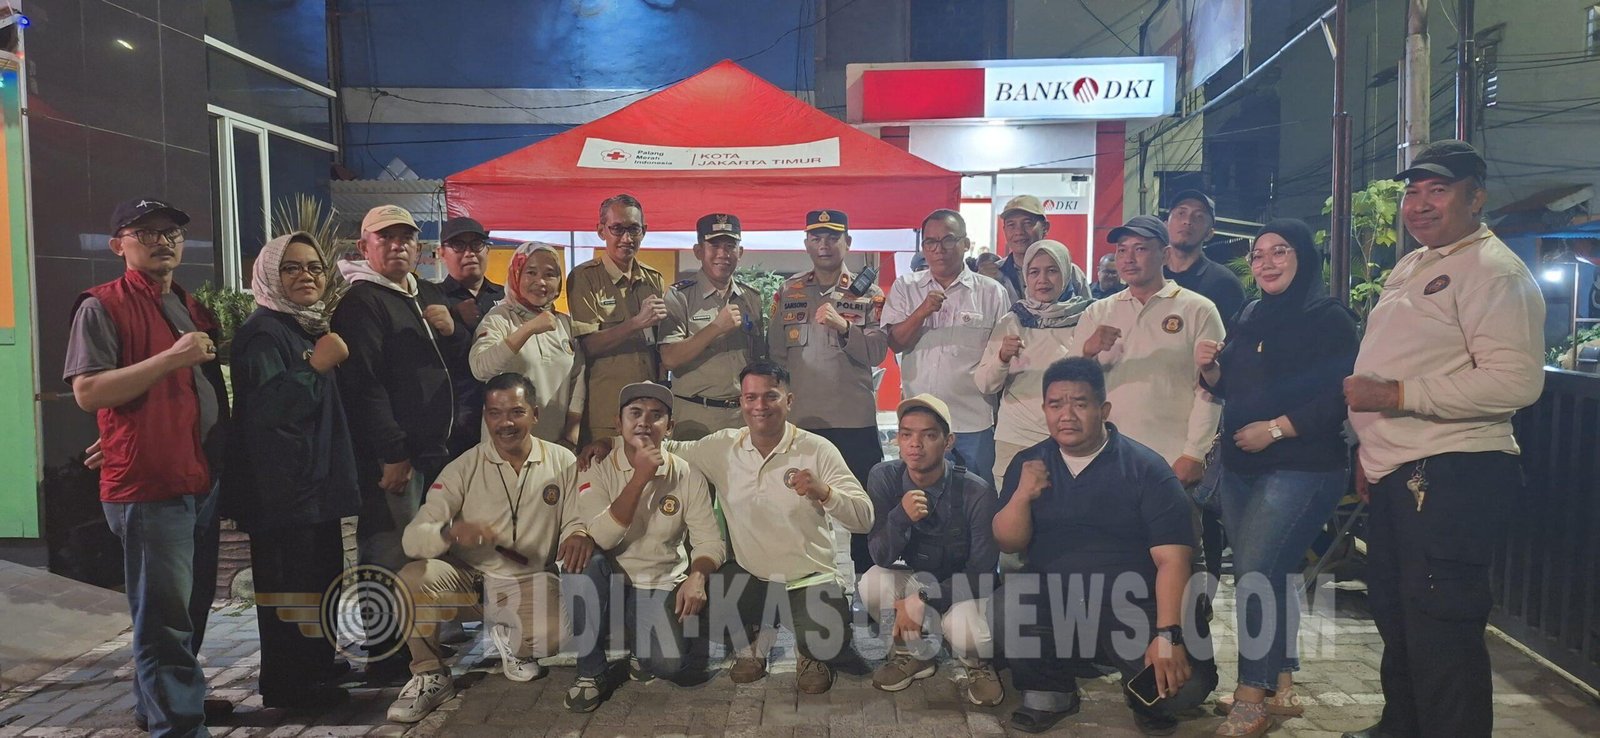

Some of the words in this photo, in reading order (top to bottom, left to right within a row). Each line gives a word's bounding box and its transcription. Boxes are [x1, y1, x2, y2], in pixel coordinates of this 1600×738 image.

[995, 81, 1072, 101] BANK
[1103, 79, 1155, 99] DKI
[772, 157, 821, 165] TIMUR
[1056, 200, 1078, 210] DKI
[836, 301, 863, 311] POLRI
